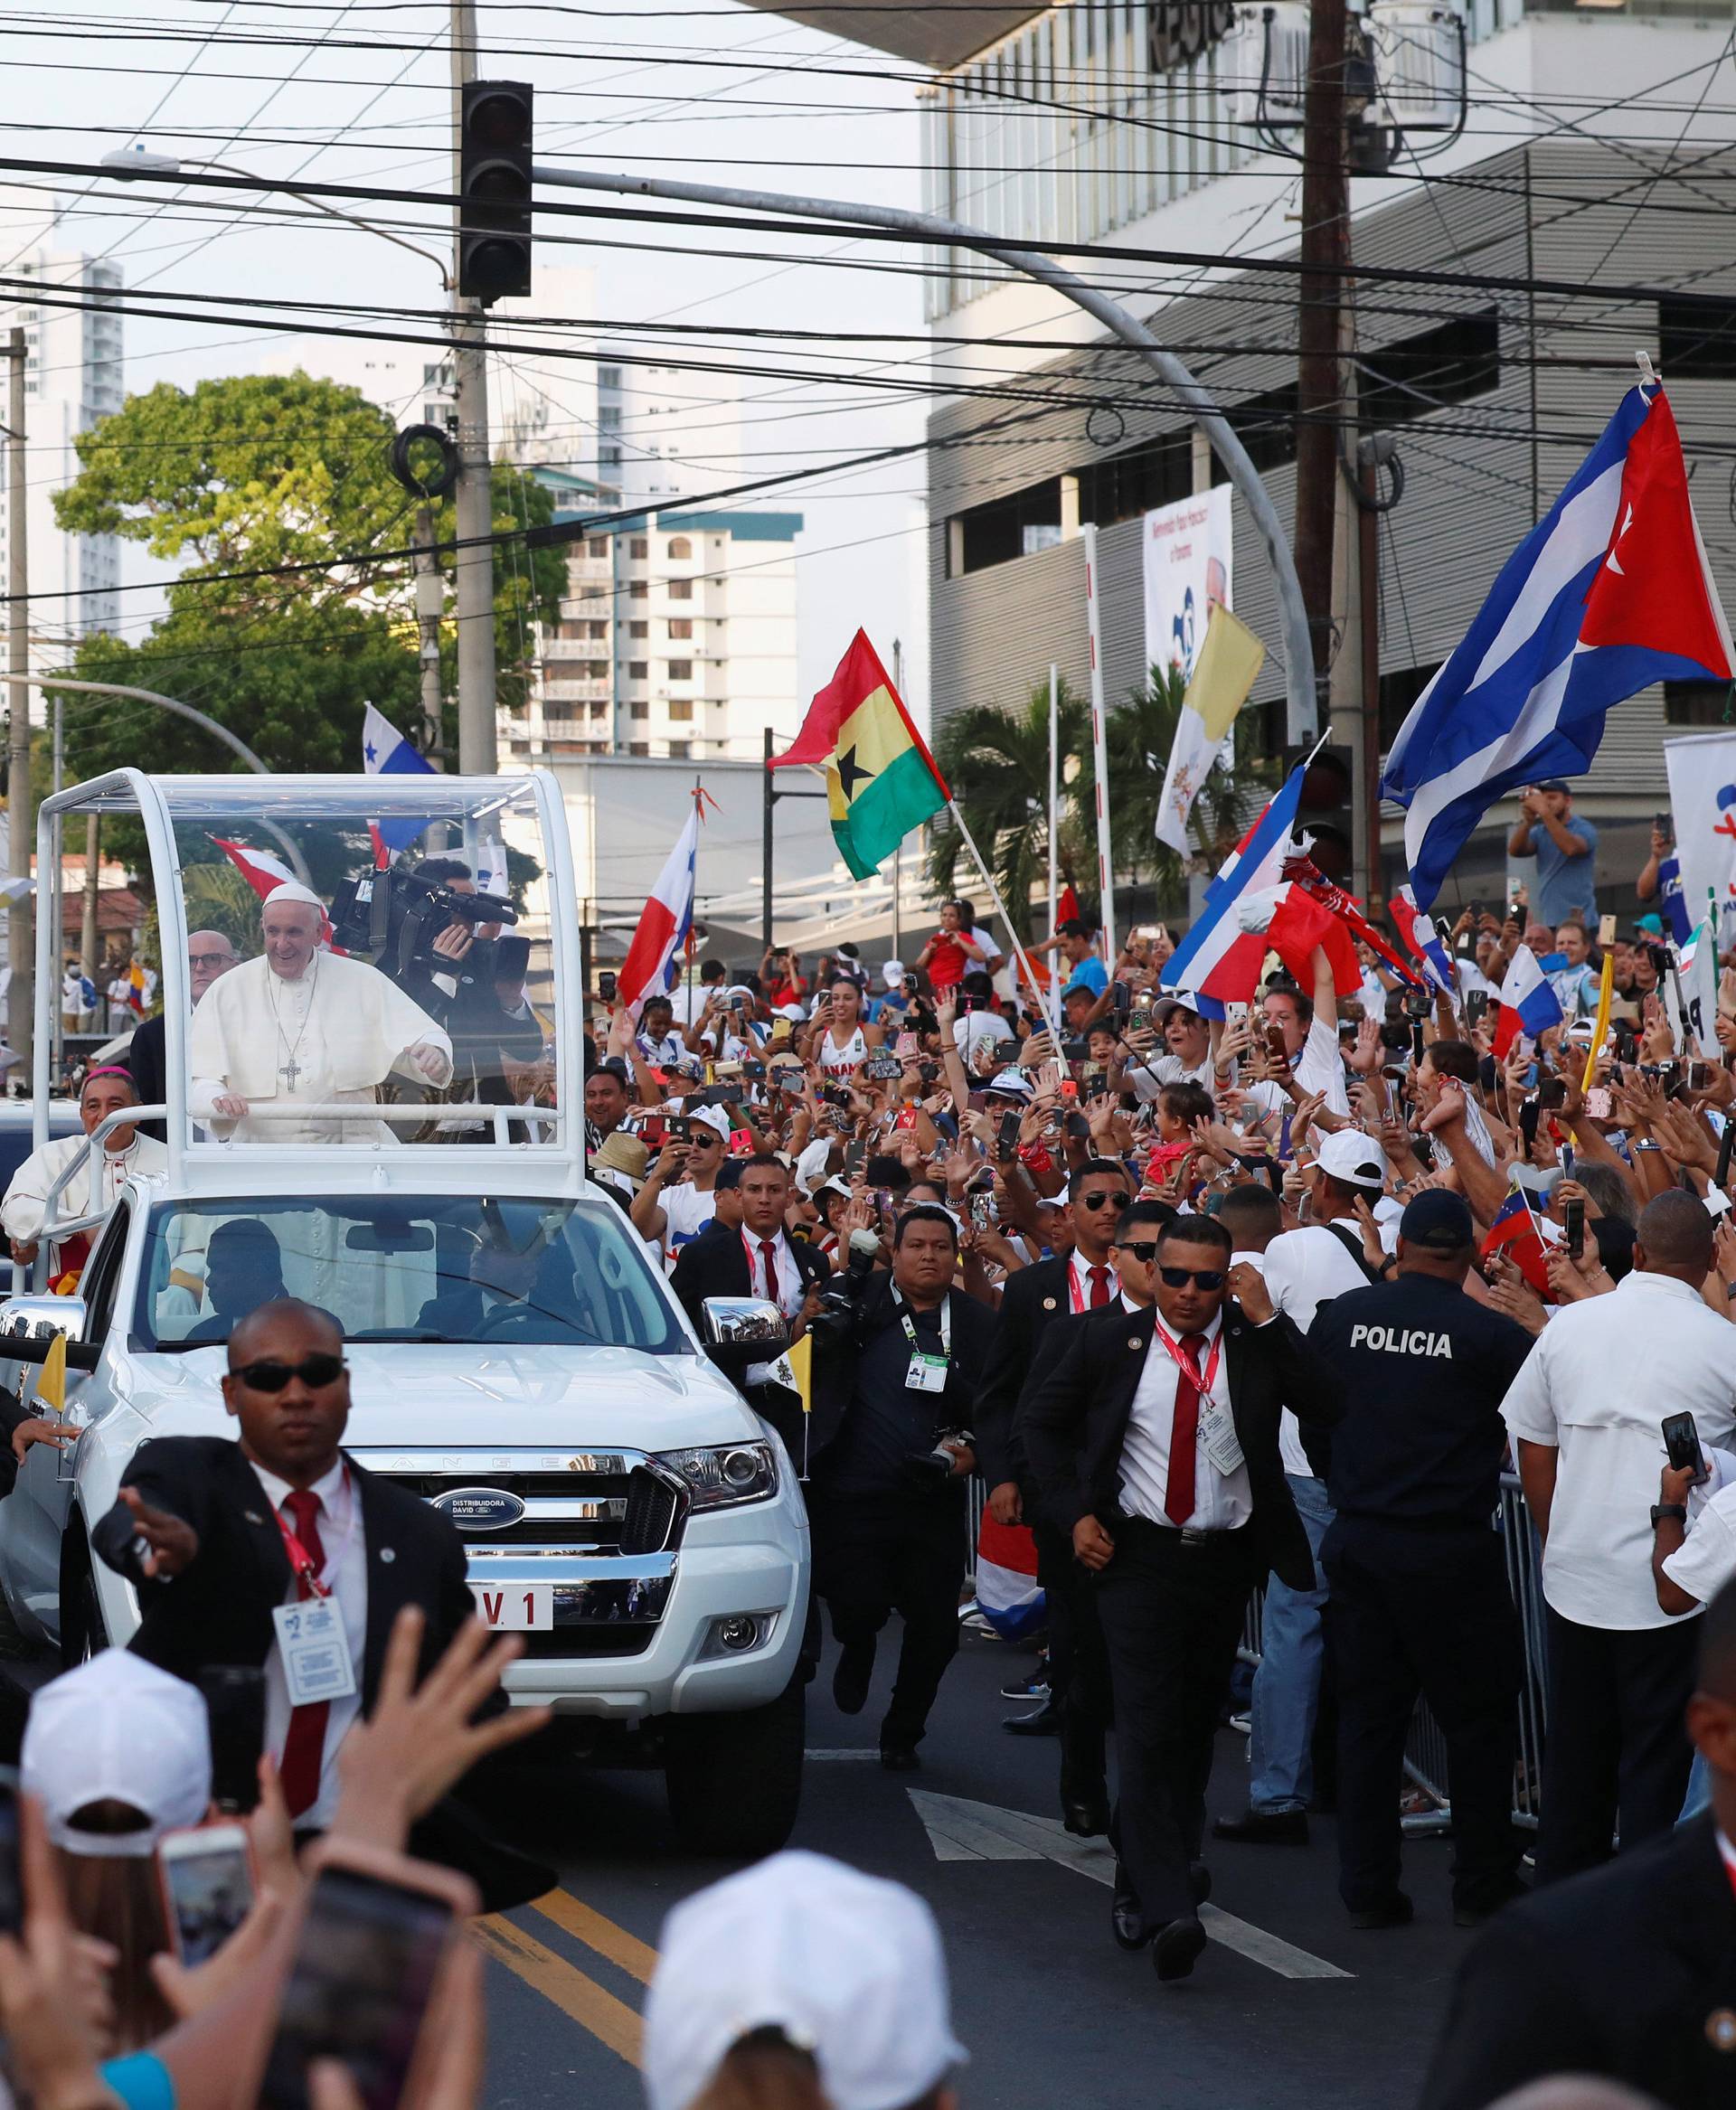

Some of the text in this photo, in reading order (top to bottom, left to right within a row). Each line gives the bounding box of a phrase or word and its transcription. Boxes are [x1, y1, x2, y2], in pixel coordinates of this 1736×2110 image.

[1350, 1324, 1453, 1359] POLICIA
[392, 1456, 610, 1469] ANGER
[523, 1592, 534, 1625] 1
